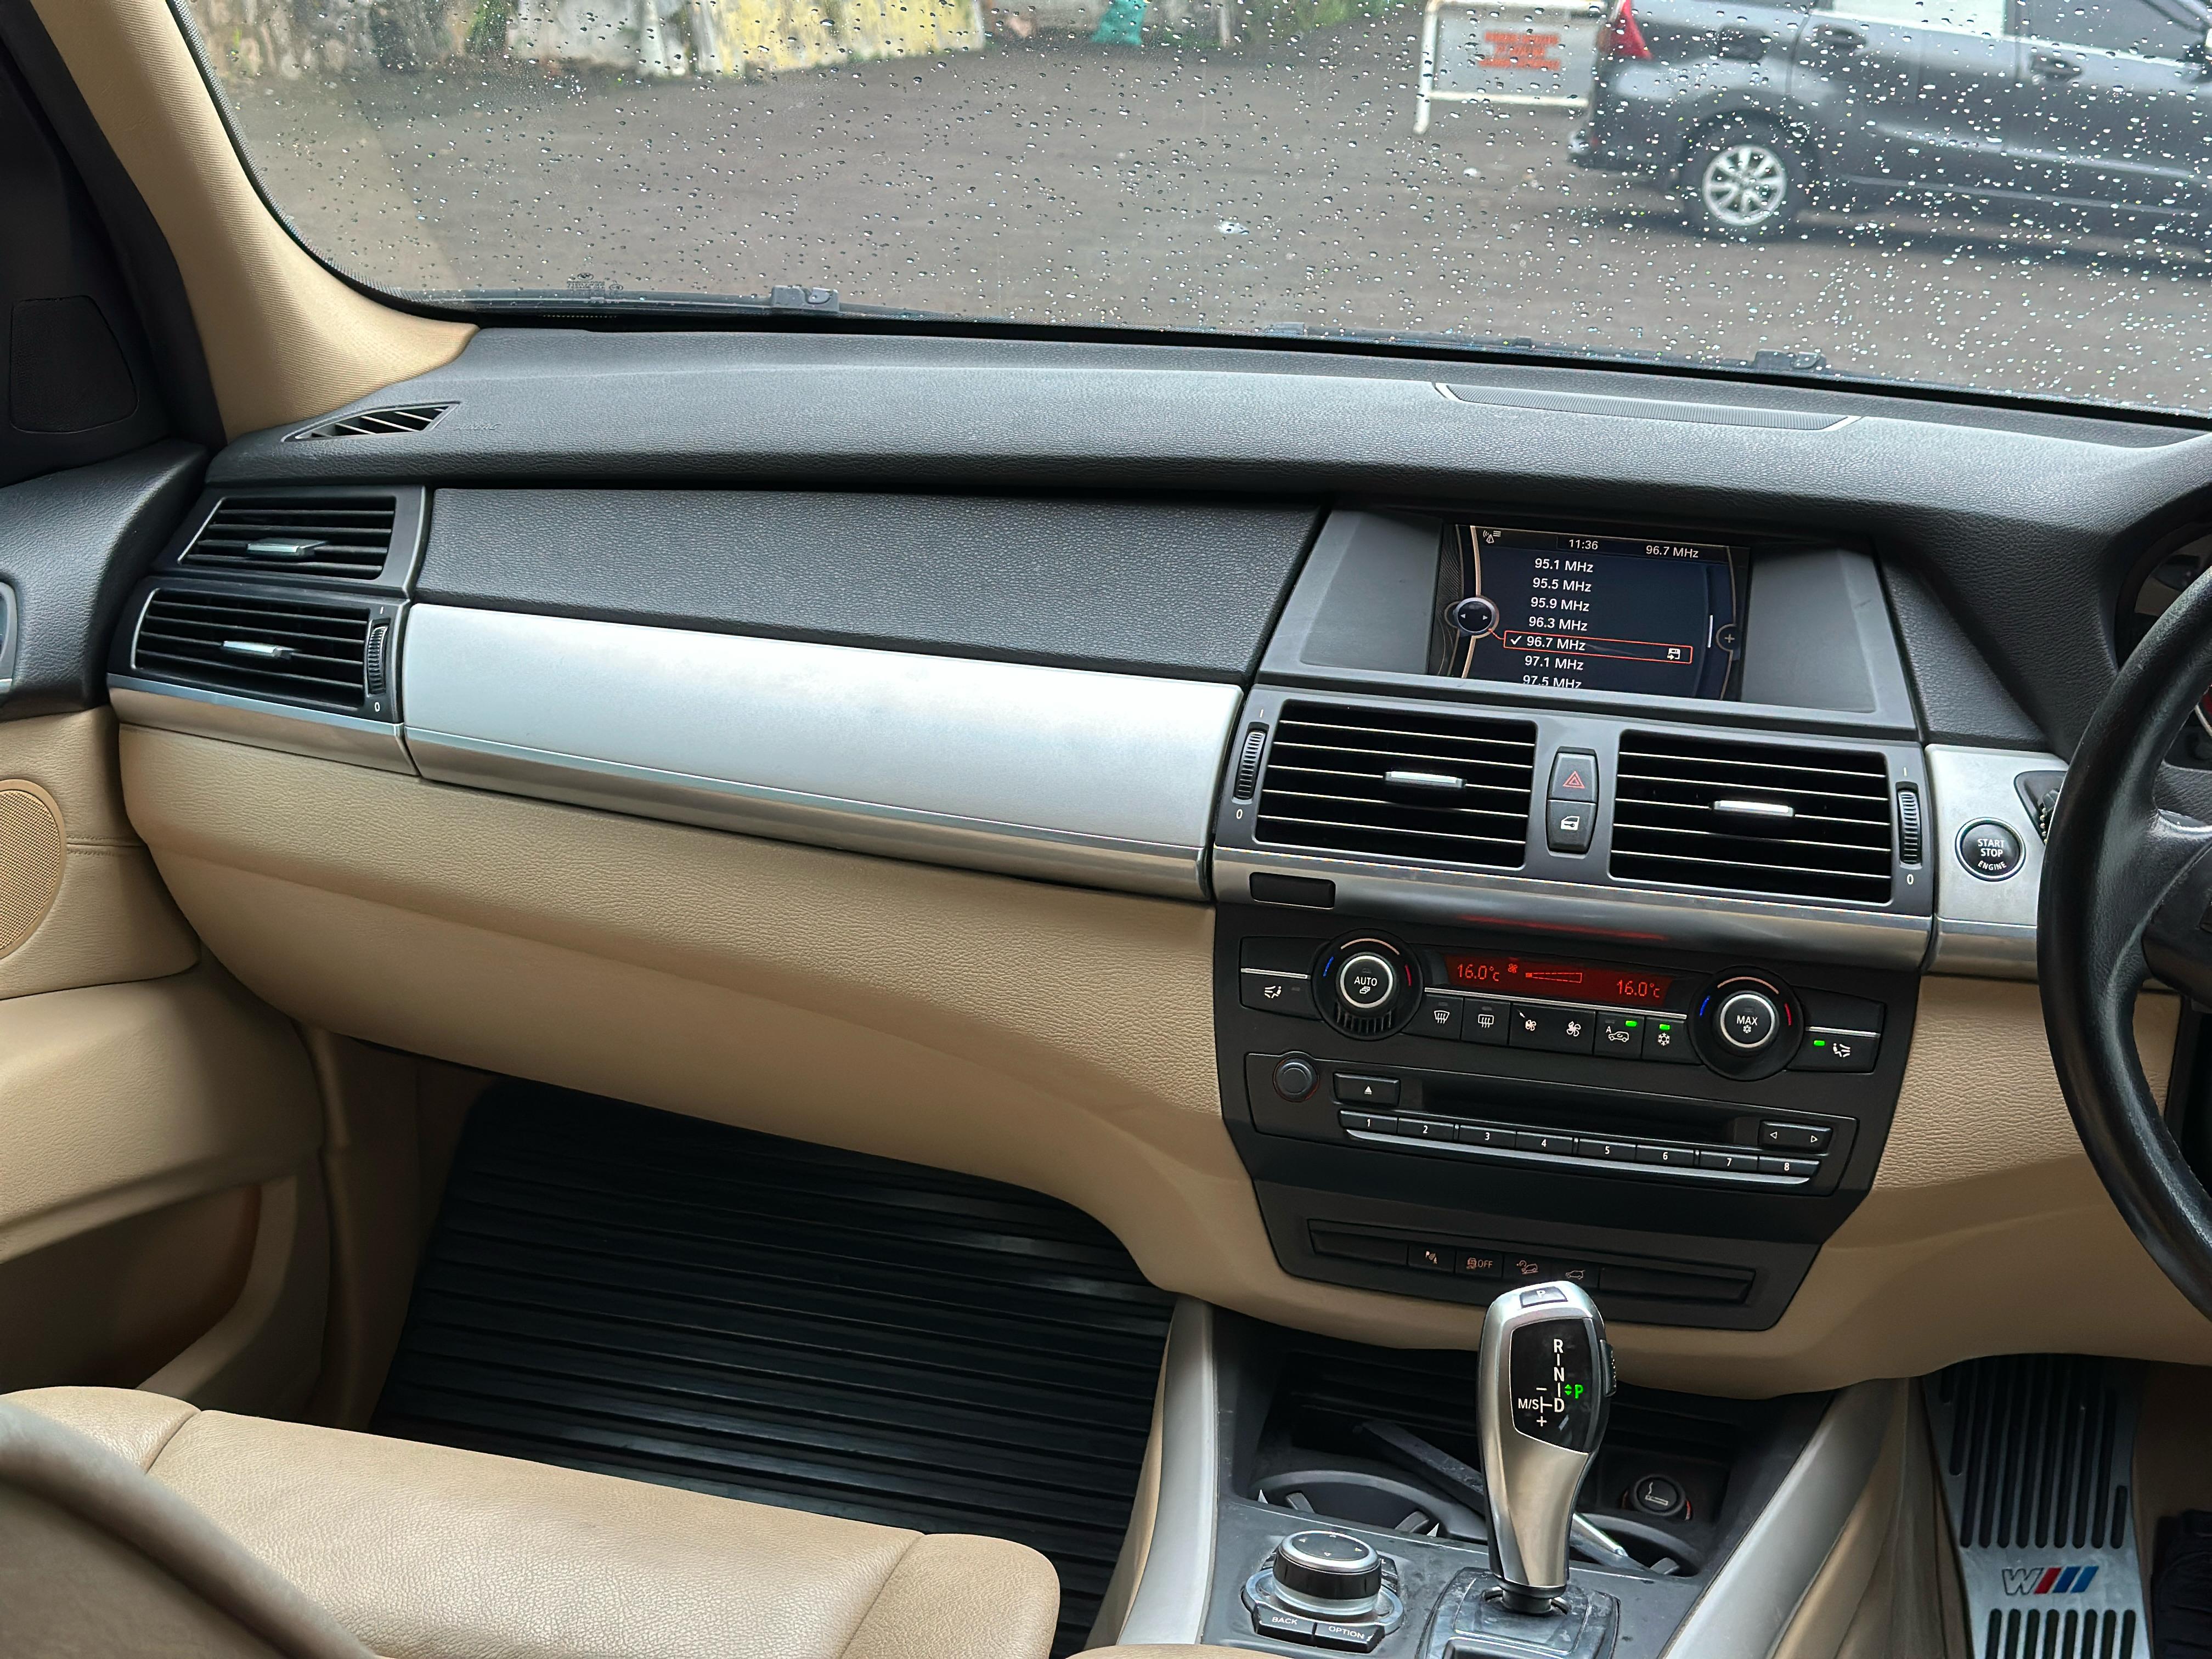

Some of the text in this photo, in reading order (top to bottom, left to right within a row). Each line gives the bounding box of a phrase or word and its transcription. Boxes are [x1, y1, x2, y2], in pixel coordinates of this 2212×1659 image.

[1570, 540, 1598, 549] 11:36
[1646, 545, 1698, 558] 96.7 MHz
[1535, 558, 1593, 572] 95.1 MHz
[1533, 578, 1591, 591] 95.5 MHz
[1531, 597, 1589, 611] 95.9 MHz
[1529, 617, 1587, 631] 96.3 MHz
[1526, 635, 1585, 651] 96.7 MHz
[1525, 656, 1583, 670] 97.1 MHz
[1523, 675, 1582, 687] 97.5 MHz
[1977, 839, 2005, 848] START
[1980, 848, 2004, 857] STOP
[1977, 861, 2007, 871] ENGINE
[1354, 976, 1378, 986] AUTO
[1736, 1015, 1758, 1025] MAX
[1367, 1119, 1371, 1127] 1
[1423, 1125, 1429, 1133] 2
[1485, 1132, 1490, 1141] 3
[1541, 1139, 1547, 1147] 4
[1604, 1146, 1610, 1154] 5
[1662, 1152, 1668, 1160] 6
[1784, 1163, 1790, 1171] 8
[1477, 1259, 1493, 1268] OFF
[1537, 1290, 1545, 1298] P
[1554, 1339, 1563, 1353] R
[1554, 1367, 1564, 1381] N
[1575, 1385, 1583, 1398] P
[1518, 1398, 1565, 1412] M/S D
[1272, 1616, 1298, 1626] BACK
[1328, 1626, 1365, 1640] OPTION
